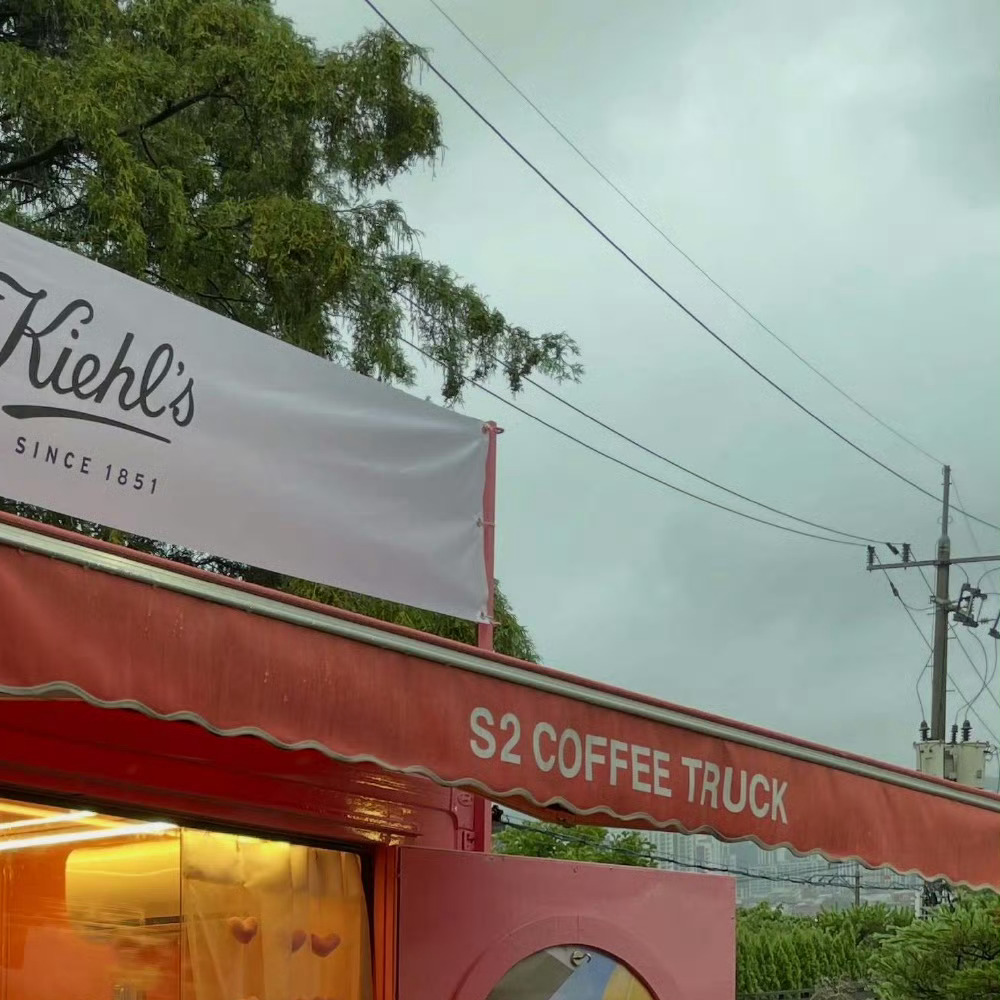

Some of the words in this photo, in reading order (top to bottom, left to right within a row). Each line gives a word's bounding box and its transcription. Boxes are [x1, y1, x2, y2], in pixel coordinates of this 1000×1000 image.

[14, 436, 92, 474] SINCE
[104, 464, 158, 495] 1851
[469, 706, 522, 765] S2
[532, 721, 673, 798] COFFEE
[680, 756, 790, 824] TRUCK
